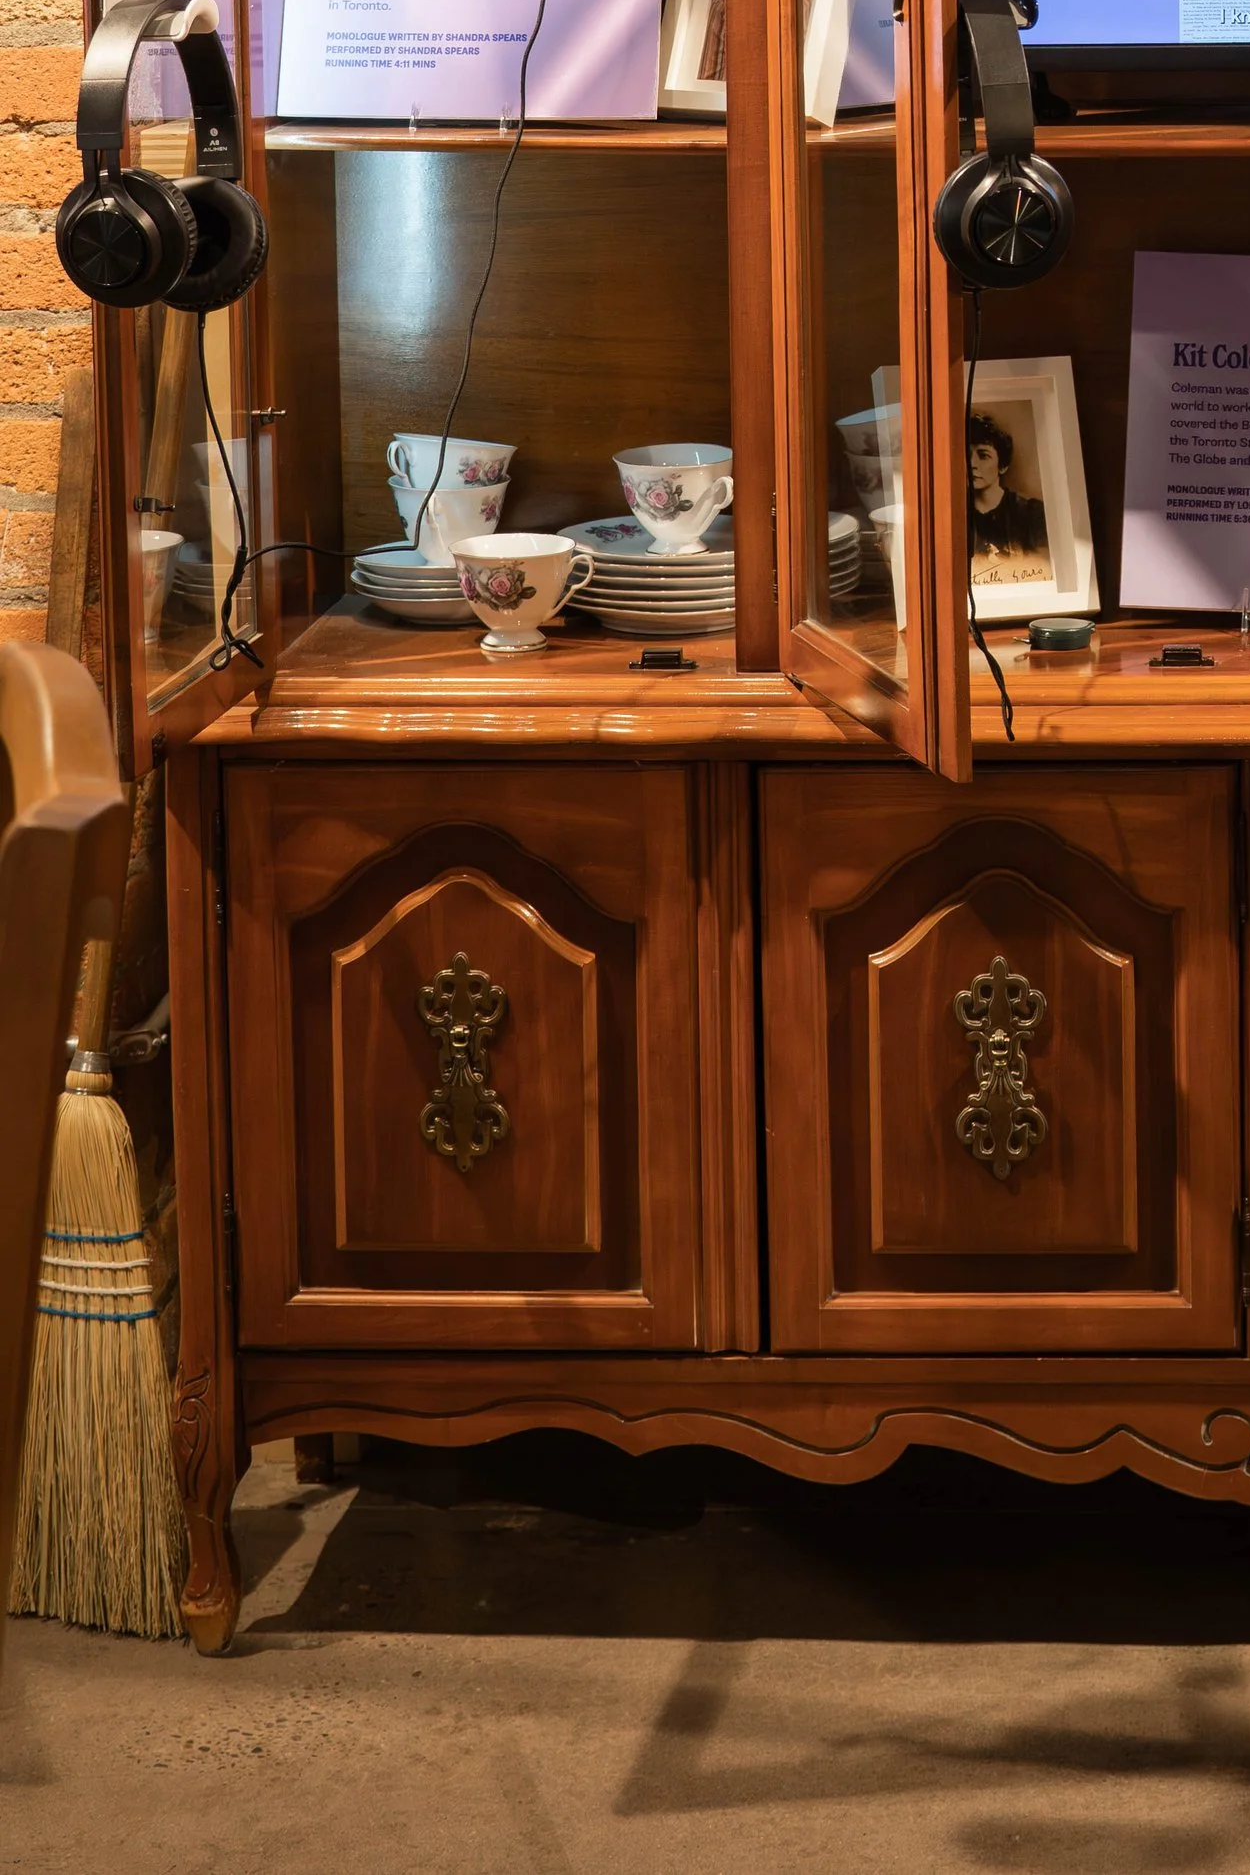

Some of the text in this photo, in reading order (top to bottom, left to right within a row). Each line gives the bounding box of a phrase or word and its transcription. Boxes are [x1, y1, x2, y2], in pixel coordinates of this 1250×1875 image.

[329, 0, 392, 11] in Toronto.
[1221, 9, 1226, 24] I
[327, 32, 386, 41] MONOLOGUE
[388, 33, 429, 41] WRITTEN
[445, 34, 490, 42] SHANDRA
[492, 34, 527, 42] SPEARS
[326, 46, 382, 54] PERFORMED
[398, 47, 443, 55] SHANDRA
[445, 47, 480, 55] SPEARS
[326, 60, 368, 68] RUNNING
[1173, 343, 1206, 368] Kit
[1171, 382, 1222, 394] Coleman
[1226, 387, 1248, 395] was
[1171, 401, 1204, 411] world
[1207, 403, 1219, 412] to
[1170, 420, 1216, 429] covered
[1220, 420, 1238, 430] the
[1170, 436, 1188, 446] the
[1192, 437, 1236, 448] Toronto
[1169, 453, 1189, 464] The
[1194, 454, 1226, 465] Globe
[1229, 455, 1250, 466] and
[1168, 485, 1225, 495] MONOLOGUE
[1167, 499, 1222, 509] PERFORMED
[1224, 501, 1235, 510] BY
[1166, 512, 1208, 522] RUNNING
[1210, 514, 1232, 523] TIME
